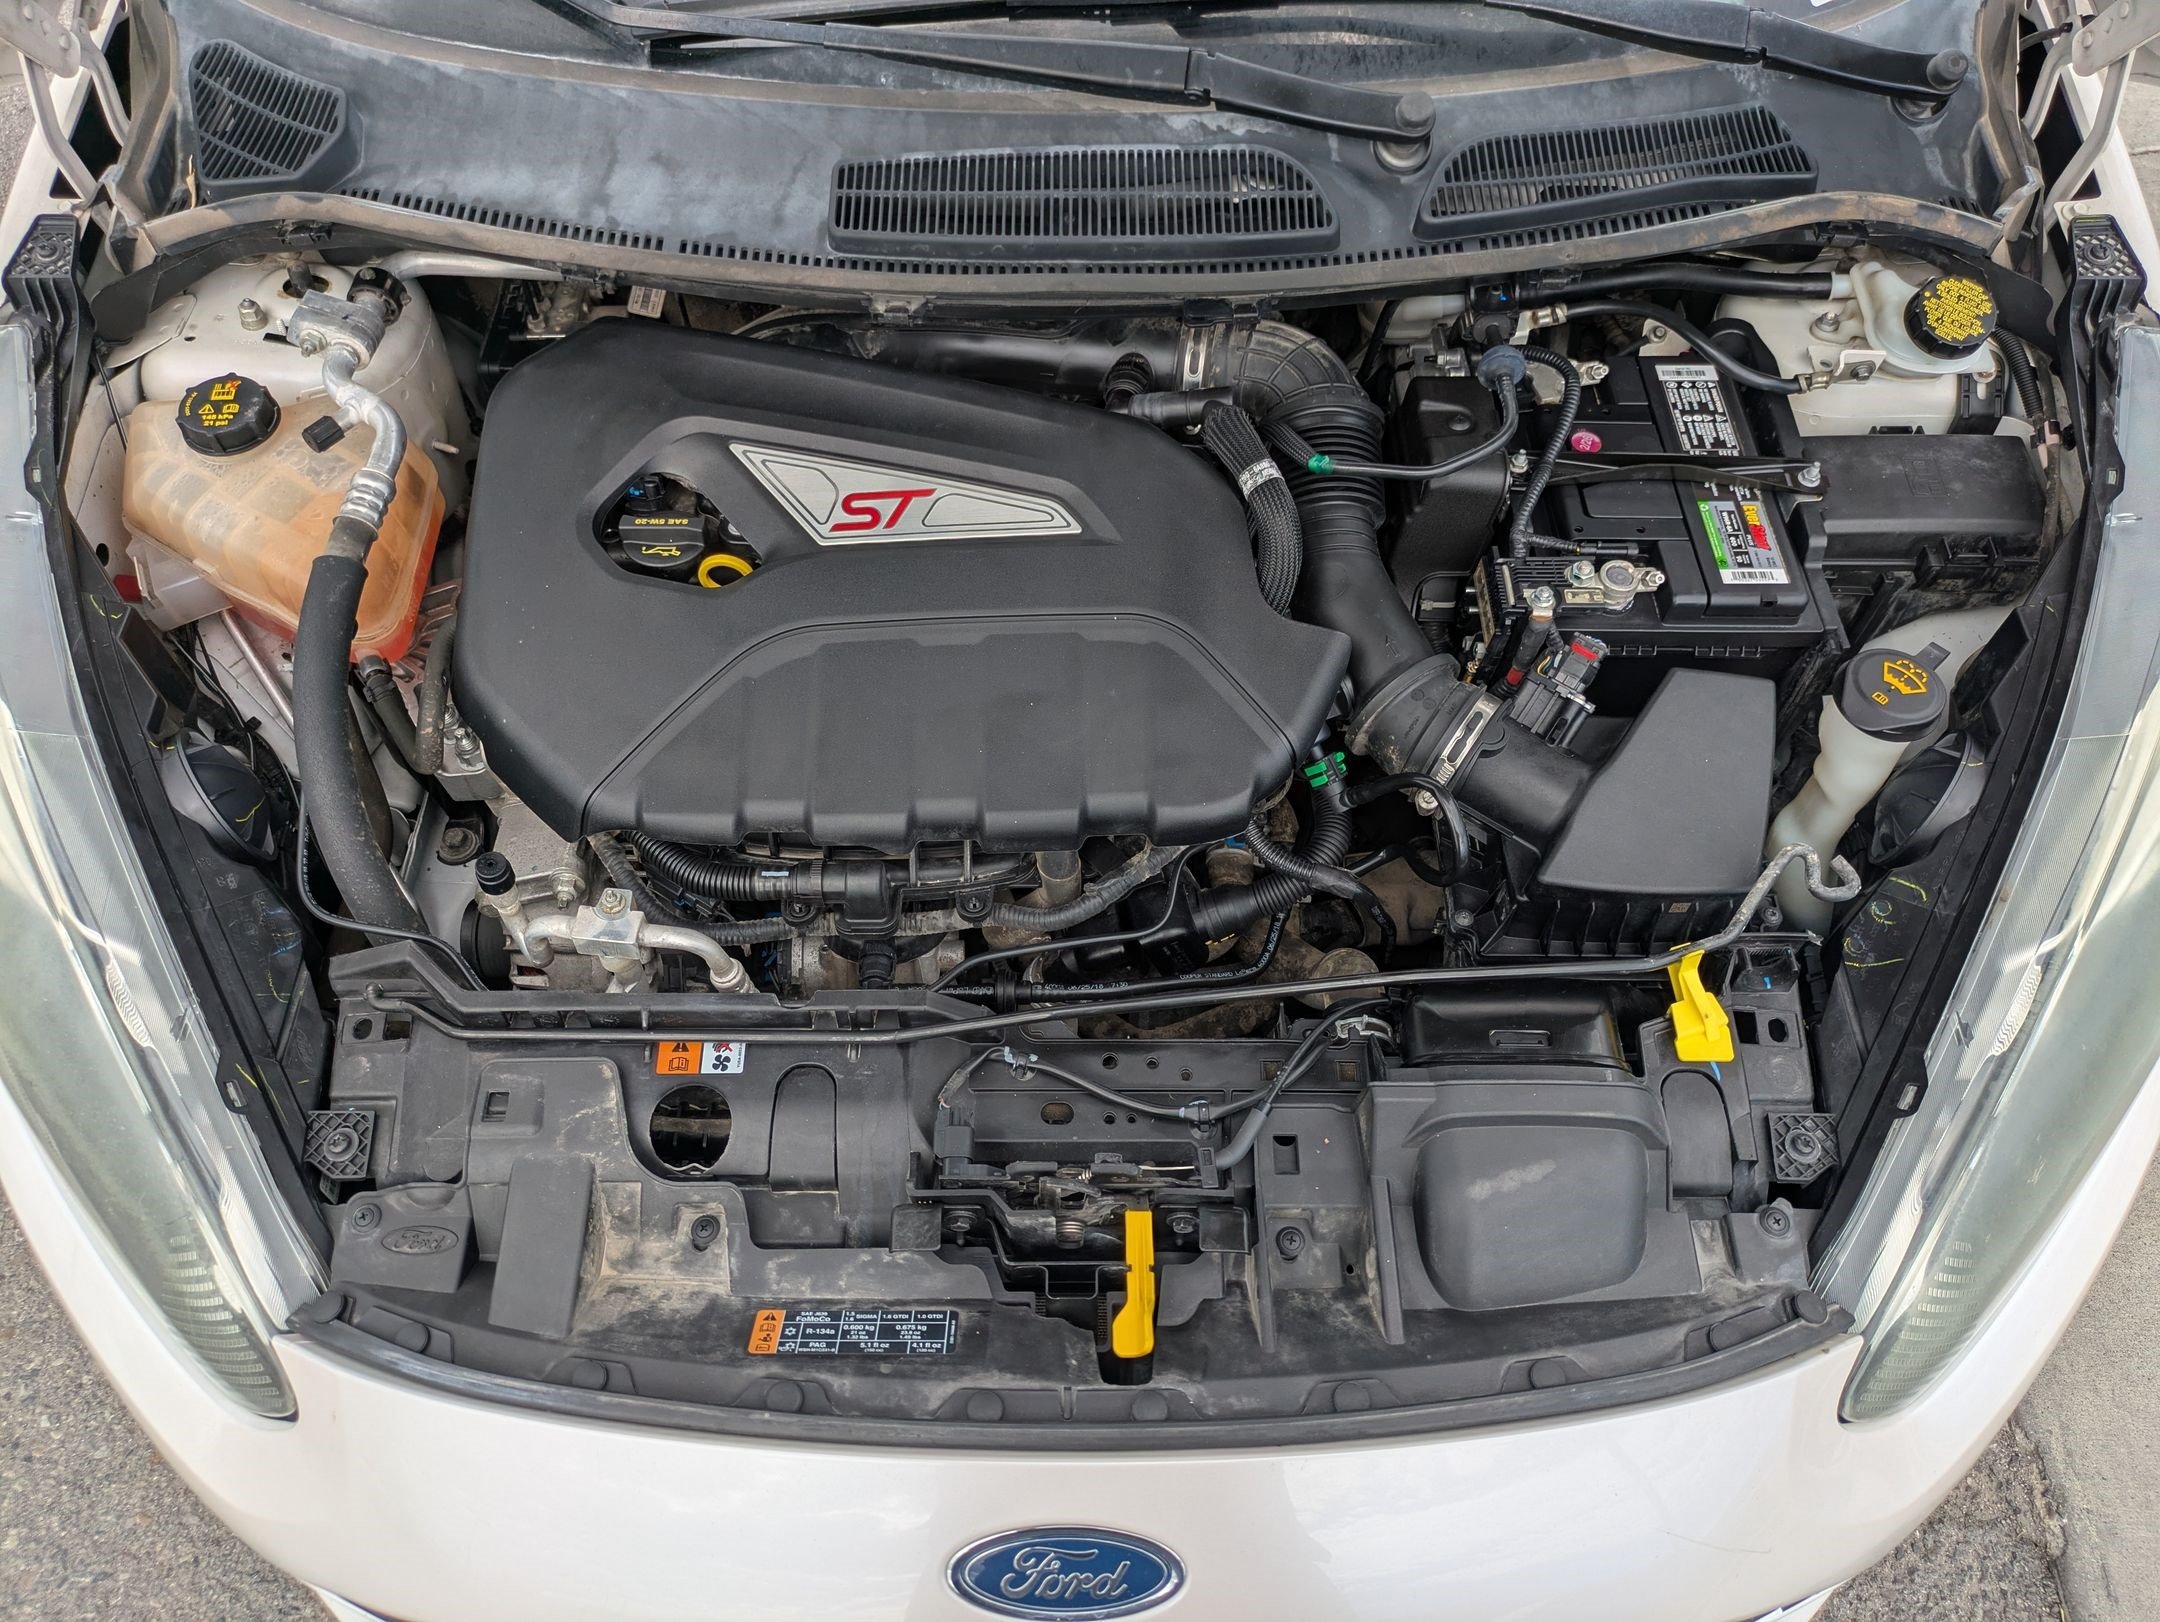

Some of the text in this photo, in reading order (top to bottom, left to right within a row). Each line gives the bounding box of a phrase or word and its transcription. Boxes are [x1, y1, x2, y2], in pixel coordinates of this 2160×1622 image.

[829, 488, 938, 533] ST
[805, 1327, 836, 1336] R-134a
[864, 1324, 875, 1332] kg
[917, 1324, 927, 1332] kg
[1000, 1546, 1131, 1599] Ford
